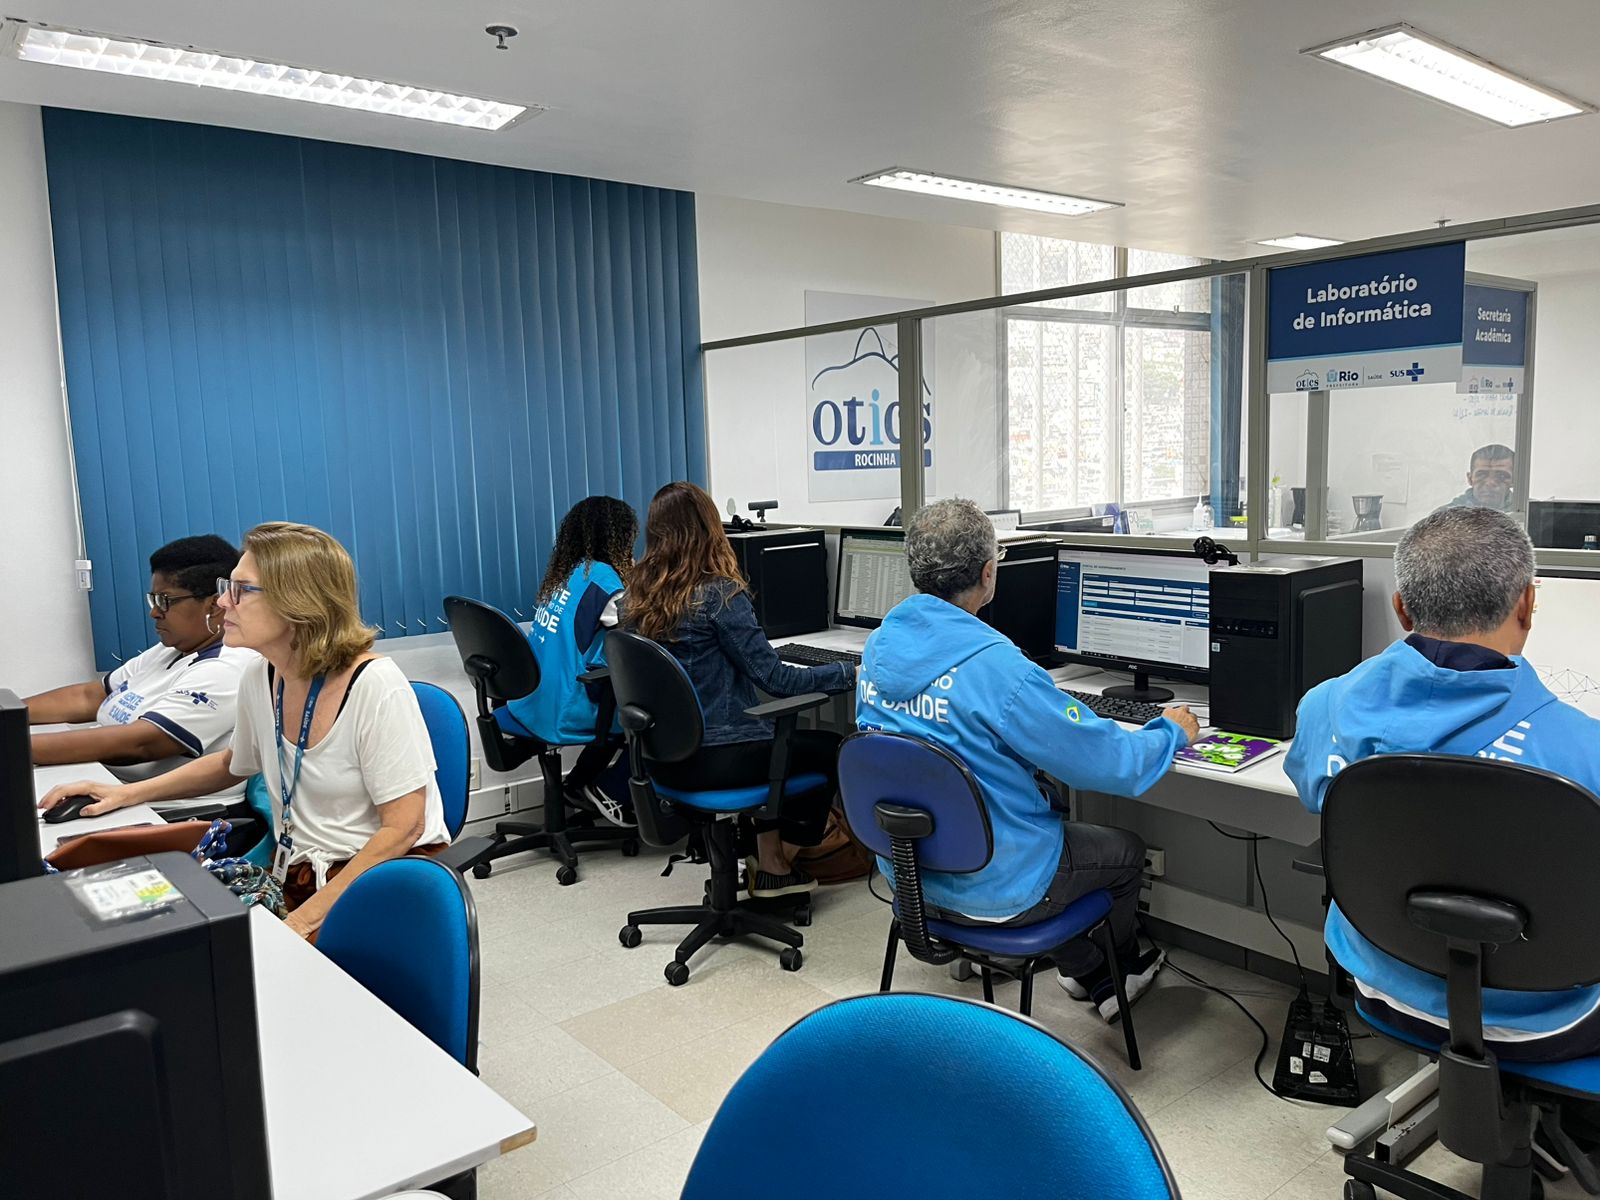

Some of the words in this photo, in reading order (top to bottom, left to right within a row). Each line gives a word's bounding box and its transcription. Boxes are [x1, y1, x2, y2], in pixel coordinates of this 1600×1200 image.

[1307, 273, 1418, 304] Laboratório
[1293, 312, 1315, 330] de
[1320, 299, 1432, 328] Informática
[1477, 307, 1512, 323] Secretaria
[1339, 371, 1359, 382] Rio
[1390, 369, 1405, 378] SUS
[855, 453, 897, 467] ROCINHA
